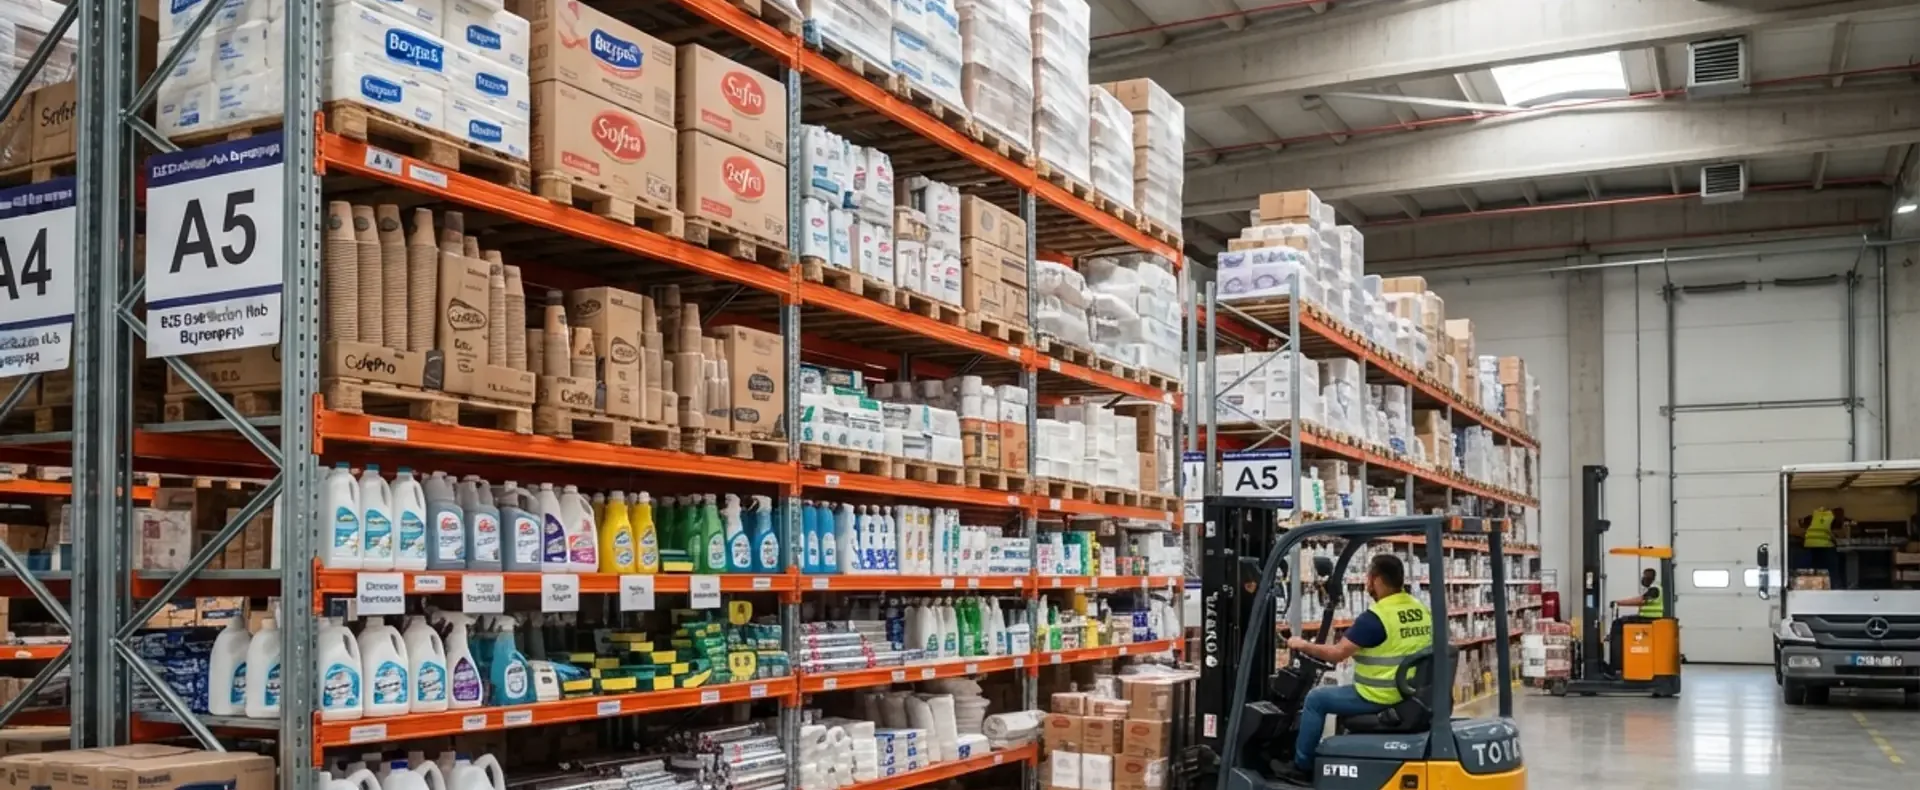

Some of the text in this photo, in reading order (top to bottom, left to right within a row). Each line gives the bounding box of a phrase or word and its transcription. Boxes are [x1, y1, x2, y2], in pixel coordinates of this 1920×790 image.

[596, 118, 640, 153] Sofra
[169, 188, 257, 273] A5
[1235, 466, 1279, 492] A5
